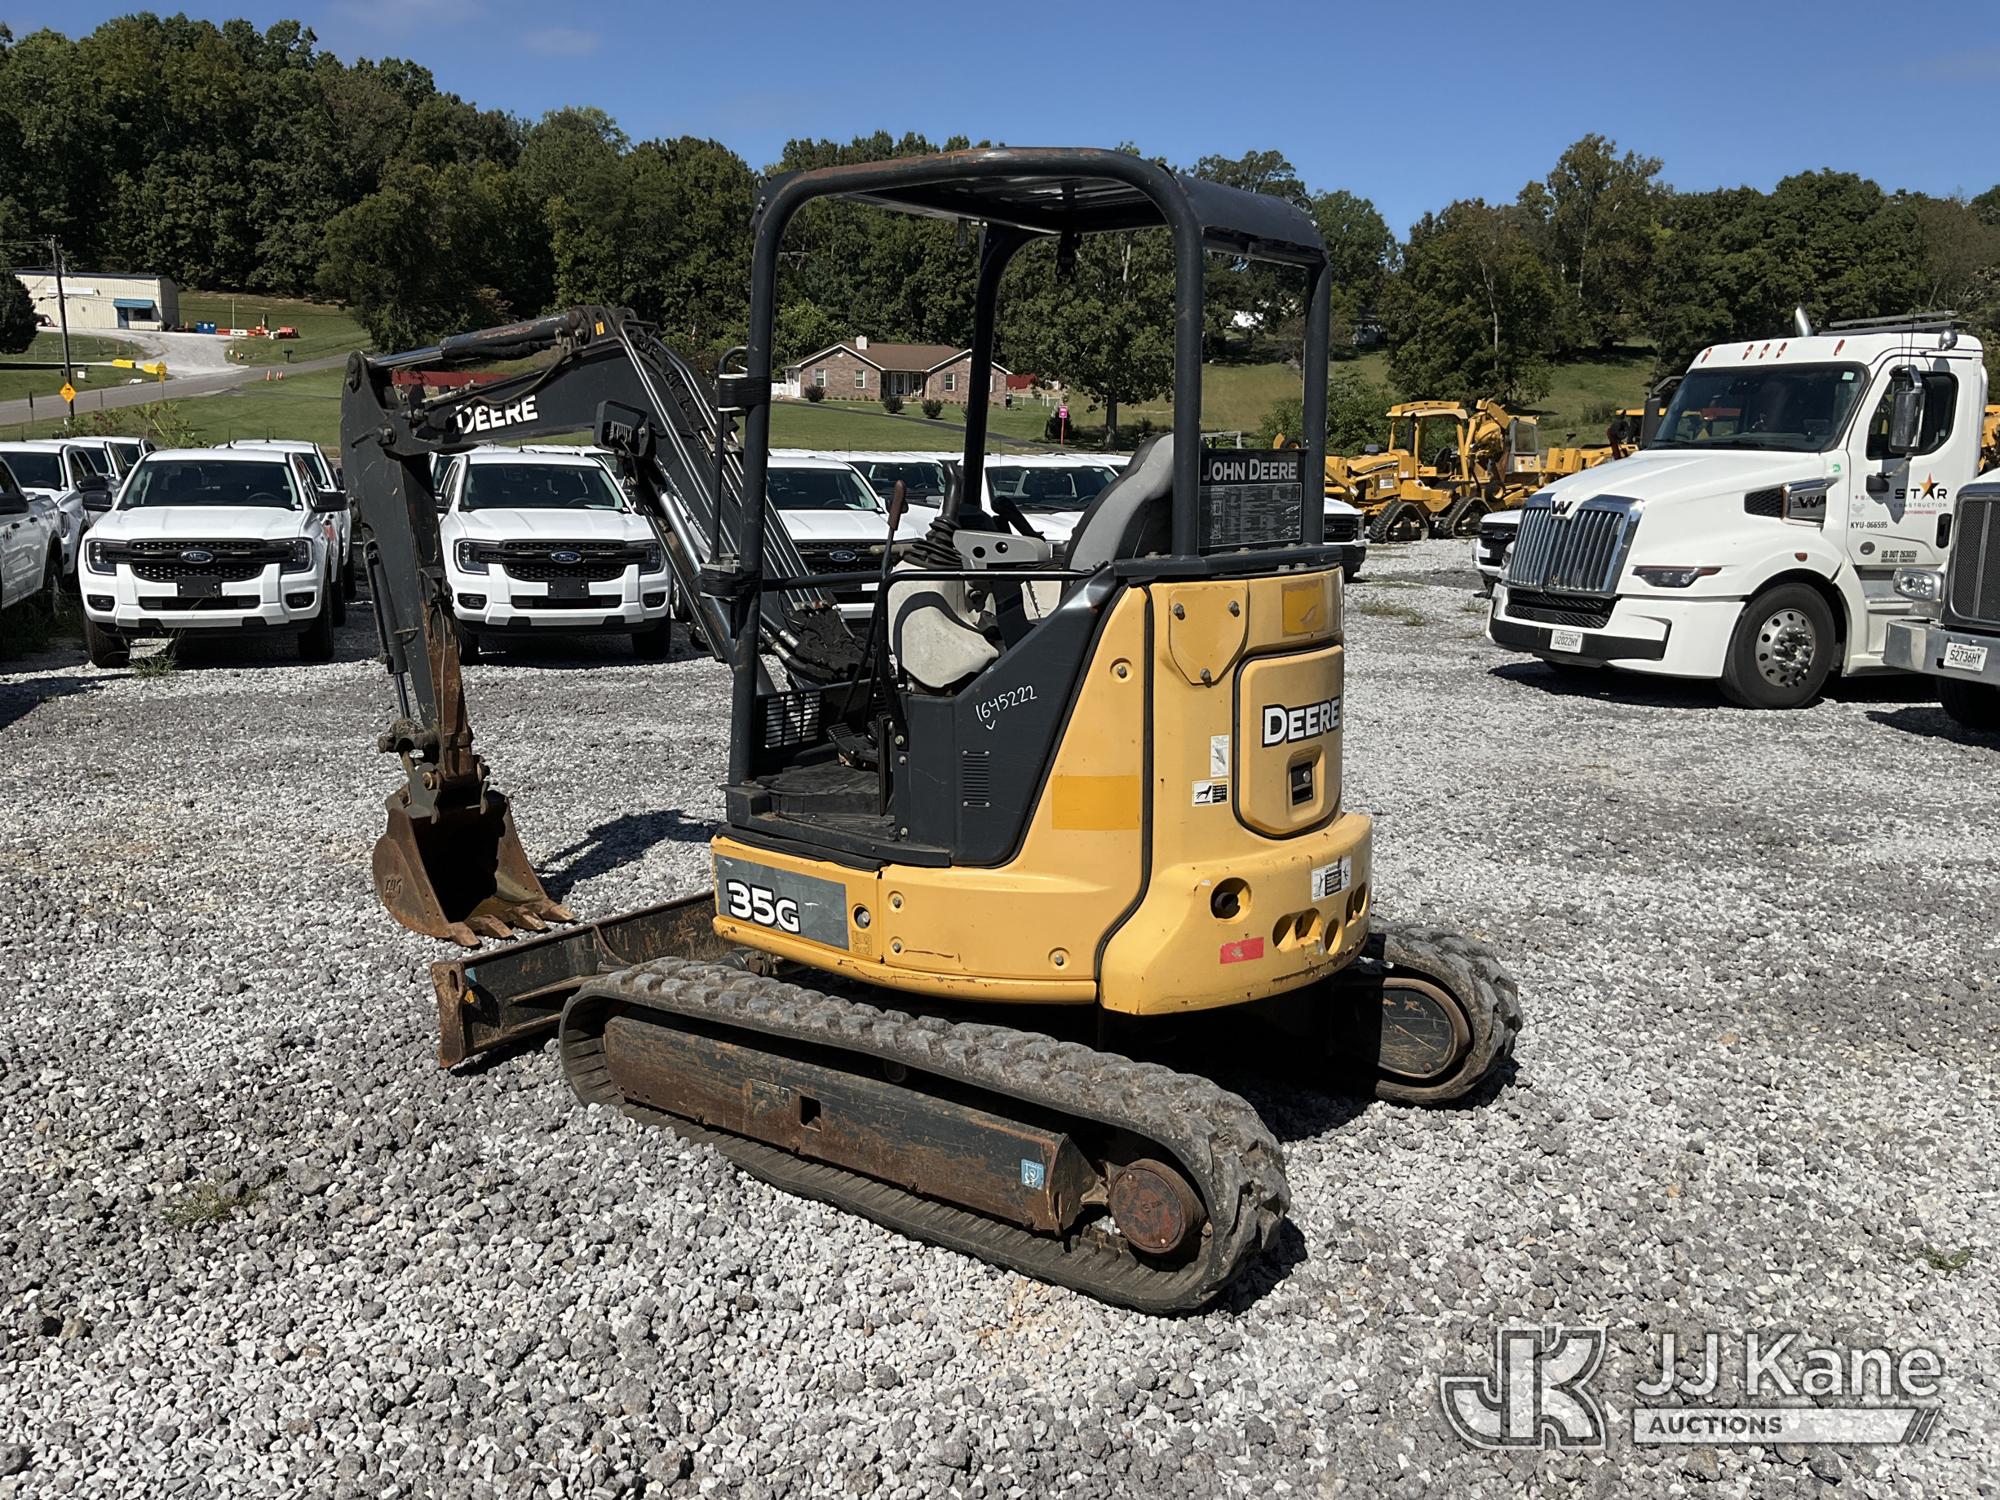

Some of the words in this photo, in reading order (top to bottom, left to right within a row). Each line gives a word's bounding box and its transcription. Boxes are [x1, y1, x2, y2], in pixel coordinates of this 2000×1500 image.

[455, 395, 539, 435] DEERE
[1202, 458, 1246, 481] JOHN
[1249, 458, 1297, 480] DEERE
[1950, 649, 1981, 664] S2736HY
[975, 685, 1038, 722] 1645222
[1263, 698, 1340, 745] DEERE
[727, 880, 801, 934] 35G
